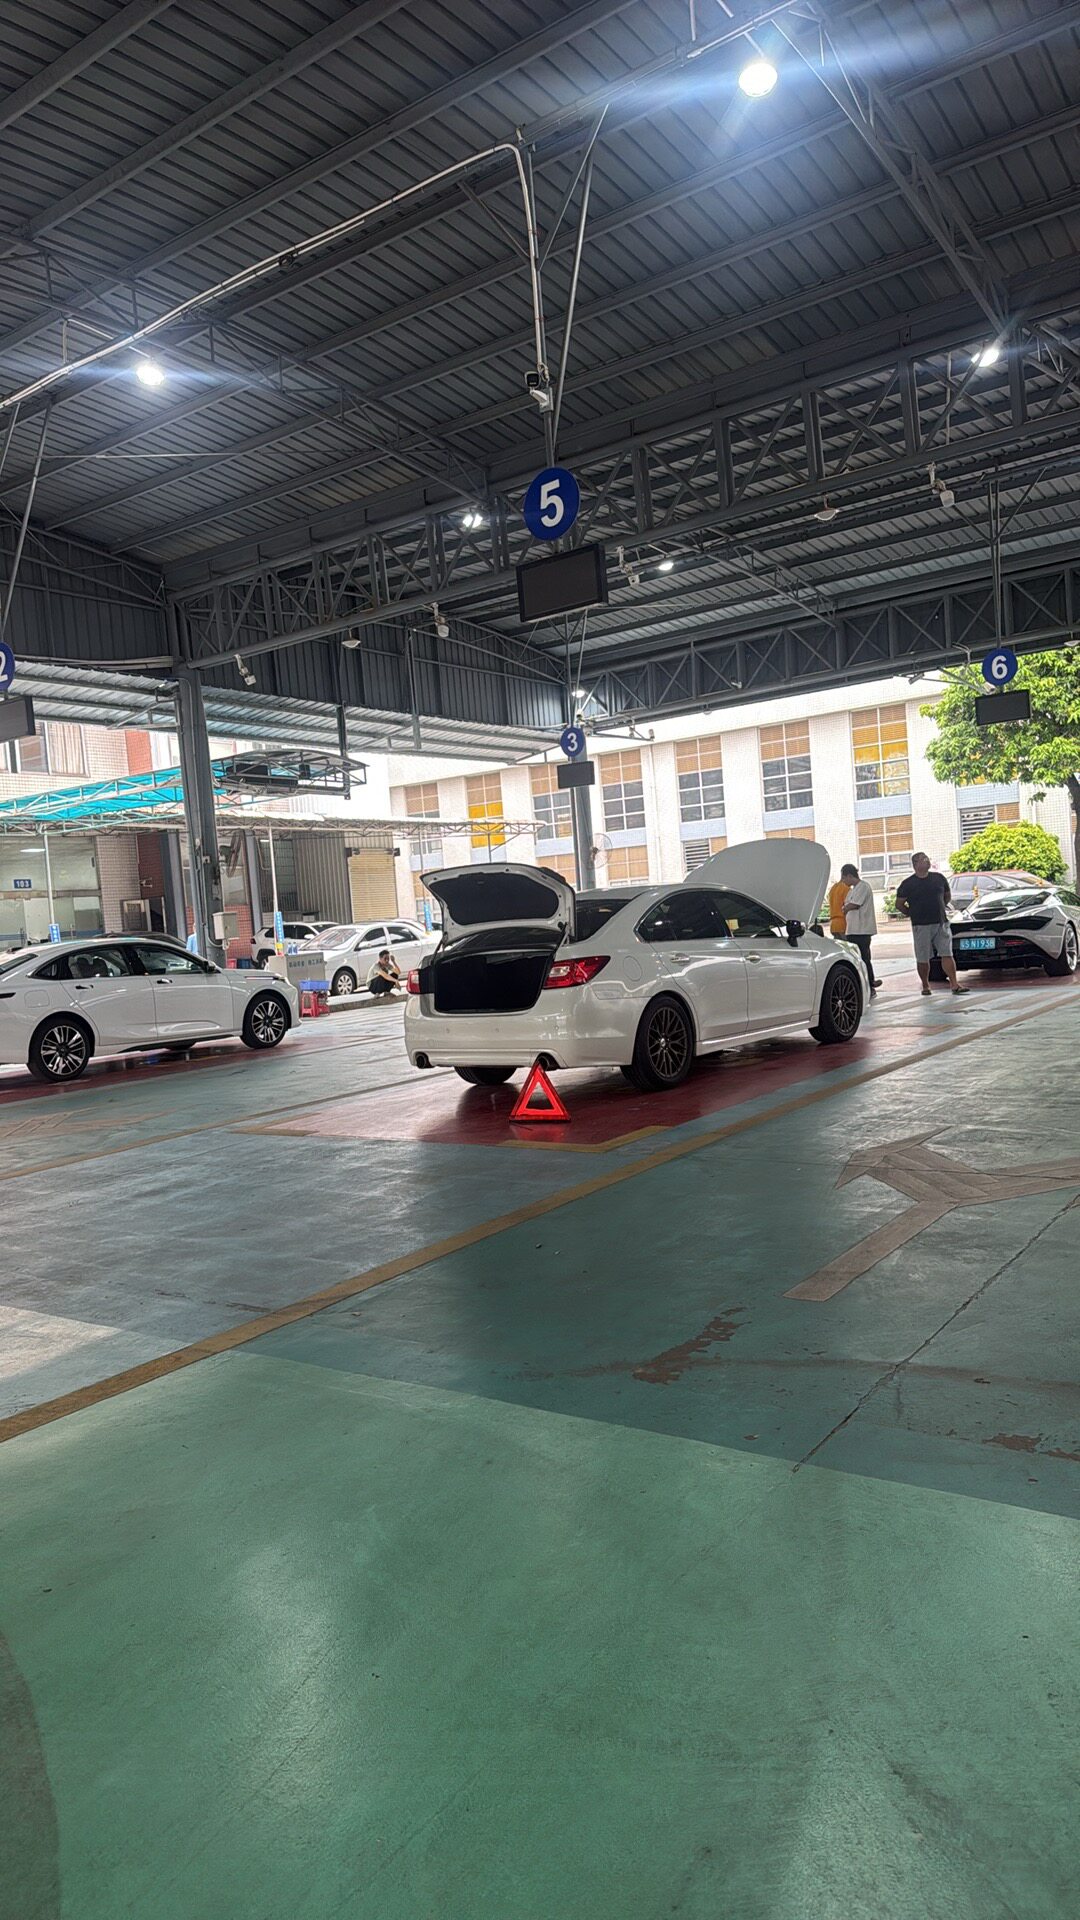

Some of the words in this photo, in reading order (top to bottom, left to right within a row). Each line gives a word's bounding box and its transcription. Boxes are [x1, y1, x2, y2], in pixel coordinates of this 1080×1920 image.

[540, 478, 565, 528] 5
[991, 655, 1008, 680] 6
[567, 731, 579, 752] 3
[16, 880, 29, 888] 103
